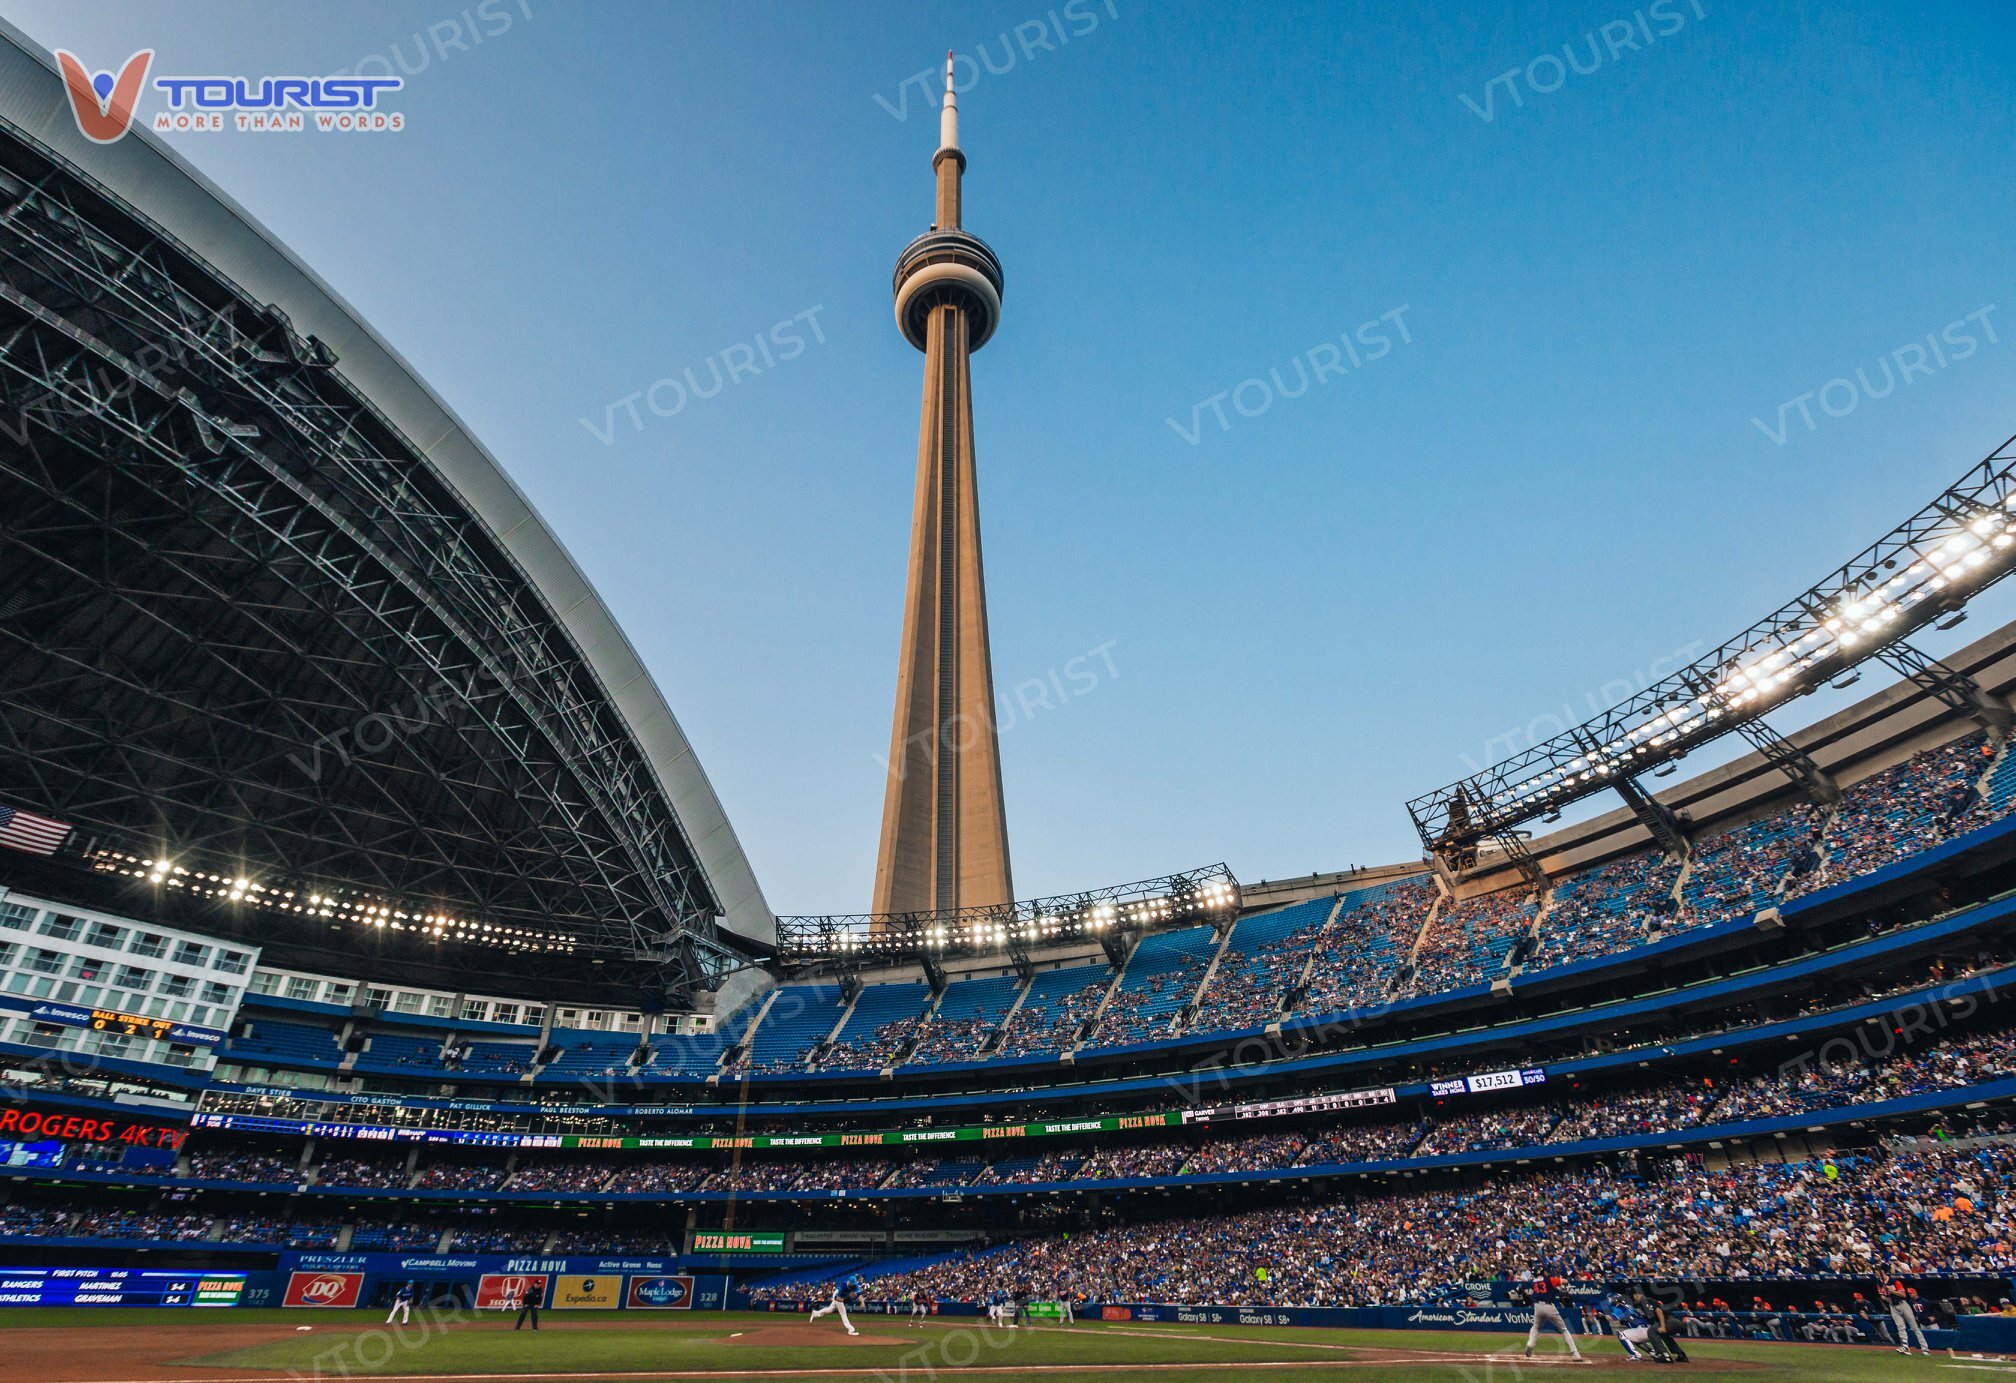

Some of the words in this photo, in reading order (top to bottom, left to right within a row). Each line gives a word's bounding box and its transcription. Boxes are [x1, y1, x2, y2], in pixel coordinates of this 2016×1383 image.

[51, 1009, 89, 1021] Invesco
[92, 1010, 116, 1021] BALL
[118, 1015, 150, 1027] STRIKE
[152, 1020, 172, 1030] OUT
[93, 1019, 105, 1030] 0
[124, 1024, 136, 1035] 2
[154, 1029, 162, 1040] 1
[186, 1030, 220, 1042] Invesco
[1475, 1074, 1515, 1089] $17,512
[1524, 1074, 1545, 1085] 50/50
[1430, 1080, 1464, 1091] WINNER
[372, 1097, 402, 1105] GASTON
[450, 1102, 462, 1110] PAT
[1061, 1124, 1072, 1132] THE
[1072, 1121, 1102, 1131] DIFFERENCE
[1119, 1117, 1142, 1129] PIZZA
[1144, 1114, 1166, 1126] NOVA
[0, 1109, 115, 1141] ROGERS
[119, 1125, 154, 1147] 4K
[156, 1128, 189, 1150] TV
[982, 1128, 1004, 1138] PIZZA
[1006, 1126, 1026, 1137] NOVA
[770, 1138, 785, 1146] TASTE
[794, 1137, 822, 1145] DIFFERENCE
[840, 1135, 862, 1145] PIZZA
[864, 1134, 884, 1144] NOVA
[918, 1132, 926, 1140] THE
[927, 1132, 956, 1140] DIFFERENCE
[578, 1137, 600, 1148] PIZZA
[602, 1138, 623, 1148] NOVA
[712, 1138, 733, 1148] PIZZA
[734, 1138, 754, 1148] NOVA
[695, 1235, 724, 1249] PIZZA
[726, 1236, 751, 1250] NOVA
[508, 1260, 538, 1272] PIZZA
[540, 1260, 566, 1272] NOVA
[599, 1261, 620, 1269] Active
[622, 1261, 642, 1269] Green
[1, 1280, 44, 1289] RANGERS
[79, 1282, 122, 1290] MARTINEZ
[197, 1281, 222, 1292] PIZZA
[310, 1281, 339, 1299] DQ
[1465, 1282, 1492, 1291] GROHE
[1534, 1282, 1547, 1294] 43
[248, 1288, 270, 1299] 375
[638, 1286, 662, 1299] Maple
[662, 1287, 684, 1298] Lodge
[700, 1292, 718, 1302] 328
[74, 1294, 122, 1304] GRAVEMAN
[566, 1293, 608, 1304] Expedia.ca
[1178, 1313, 1198, 1324] Galaxy
[1240, 1314, 1262, 1326] Galaxy
[1408, 1311, 1454, 1323] American
[1454, 1310, 1502, 1325] Standard
[1504, 1312, 1535, 1324] VorMa
